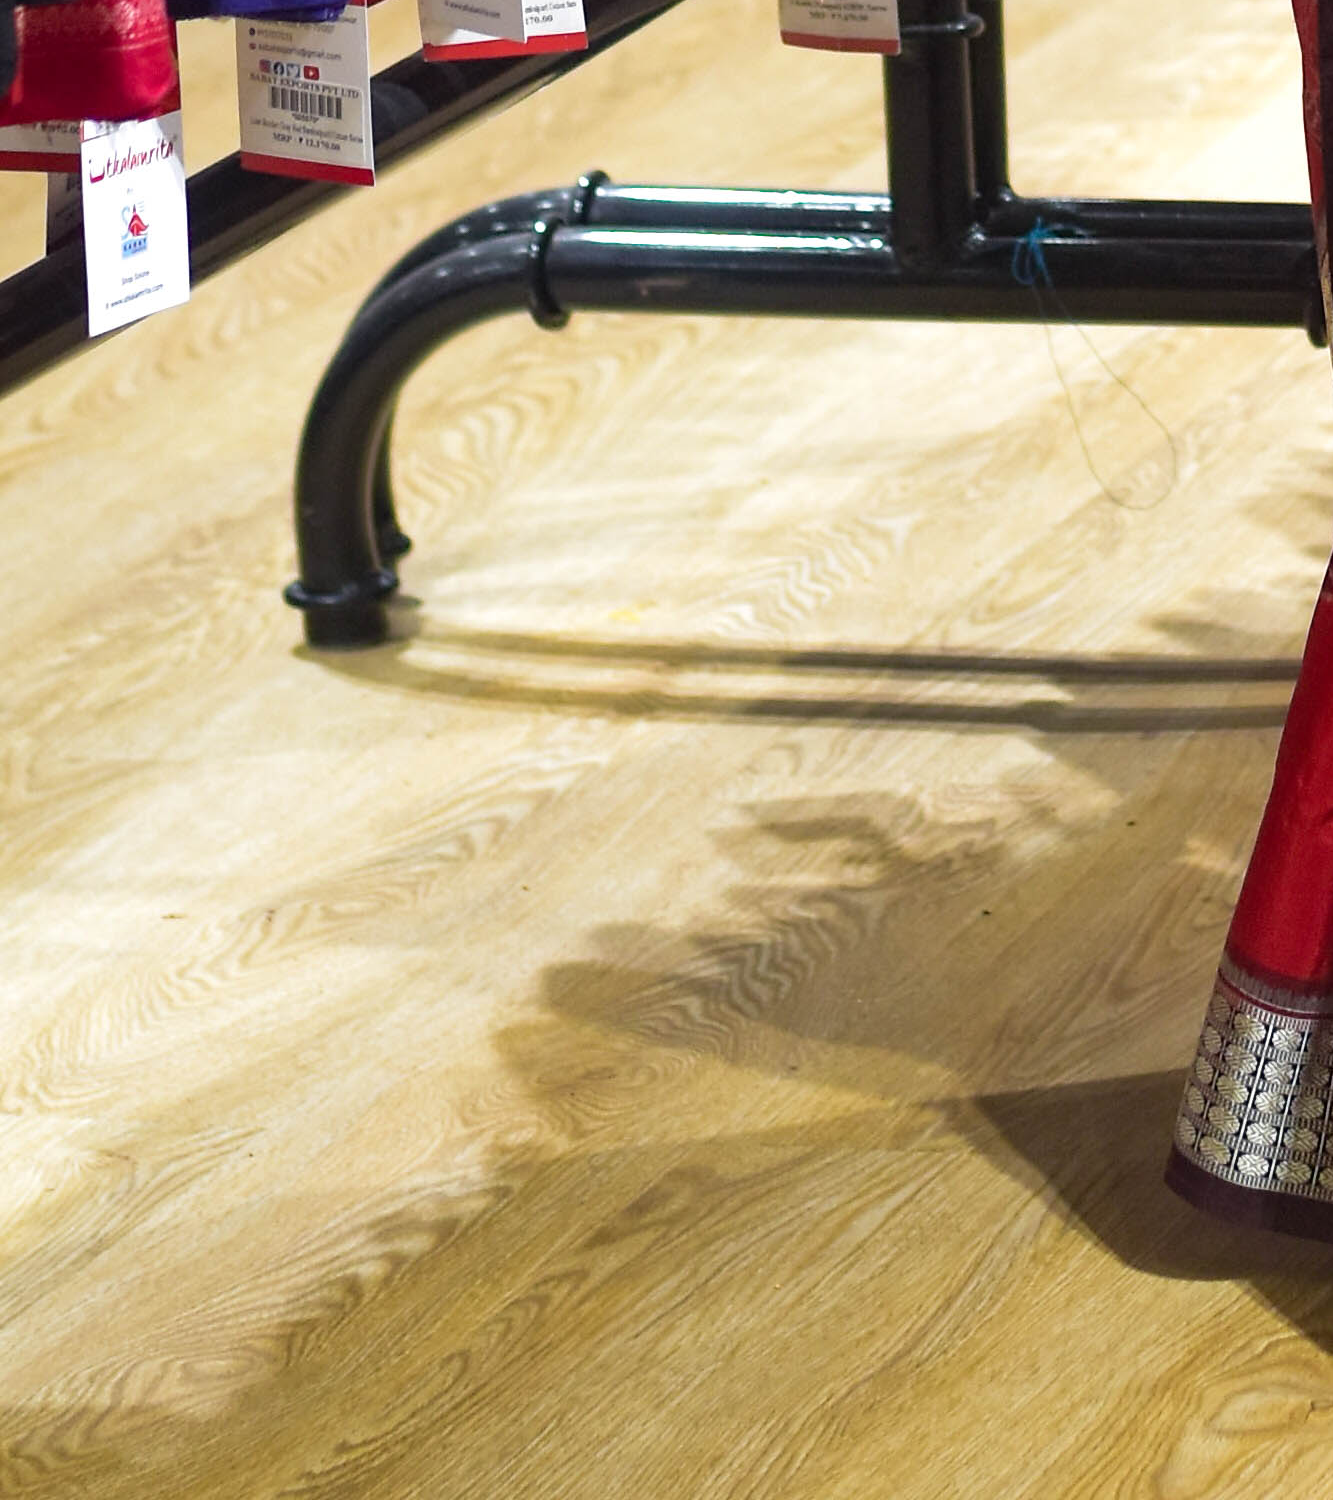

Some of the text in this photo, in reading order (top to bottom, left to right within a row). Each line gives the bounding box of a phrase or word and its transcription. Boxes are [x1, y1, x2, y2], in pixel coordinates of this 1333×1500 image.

[280, 78, 320, 92] EXPORTS
[322, 85, 338, 96] PVT
[341, 87, 359, 99] LTD
